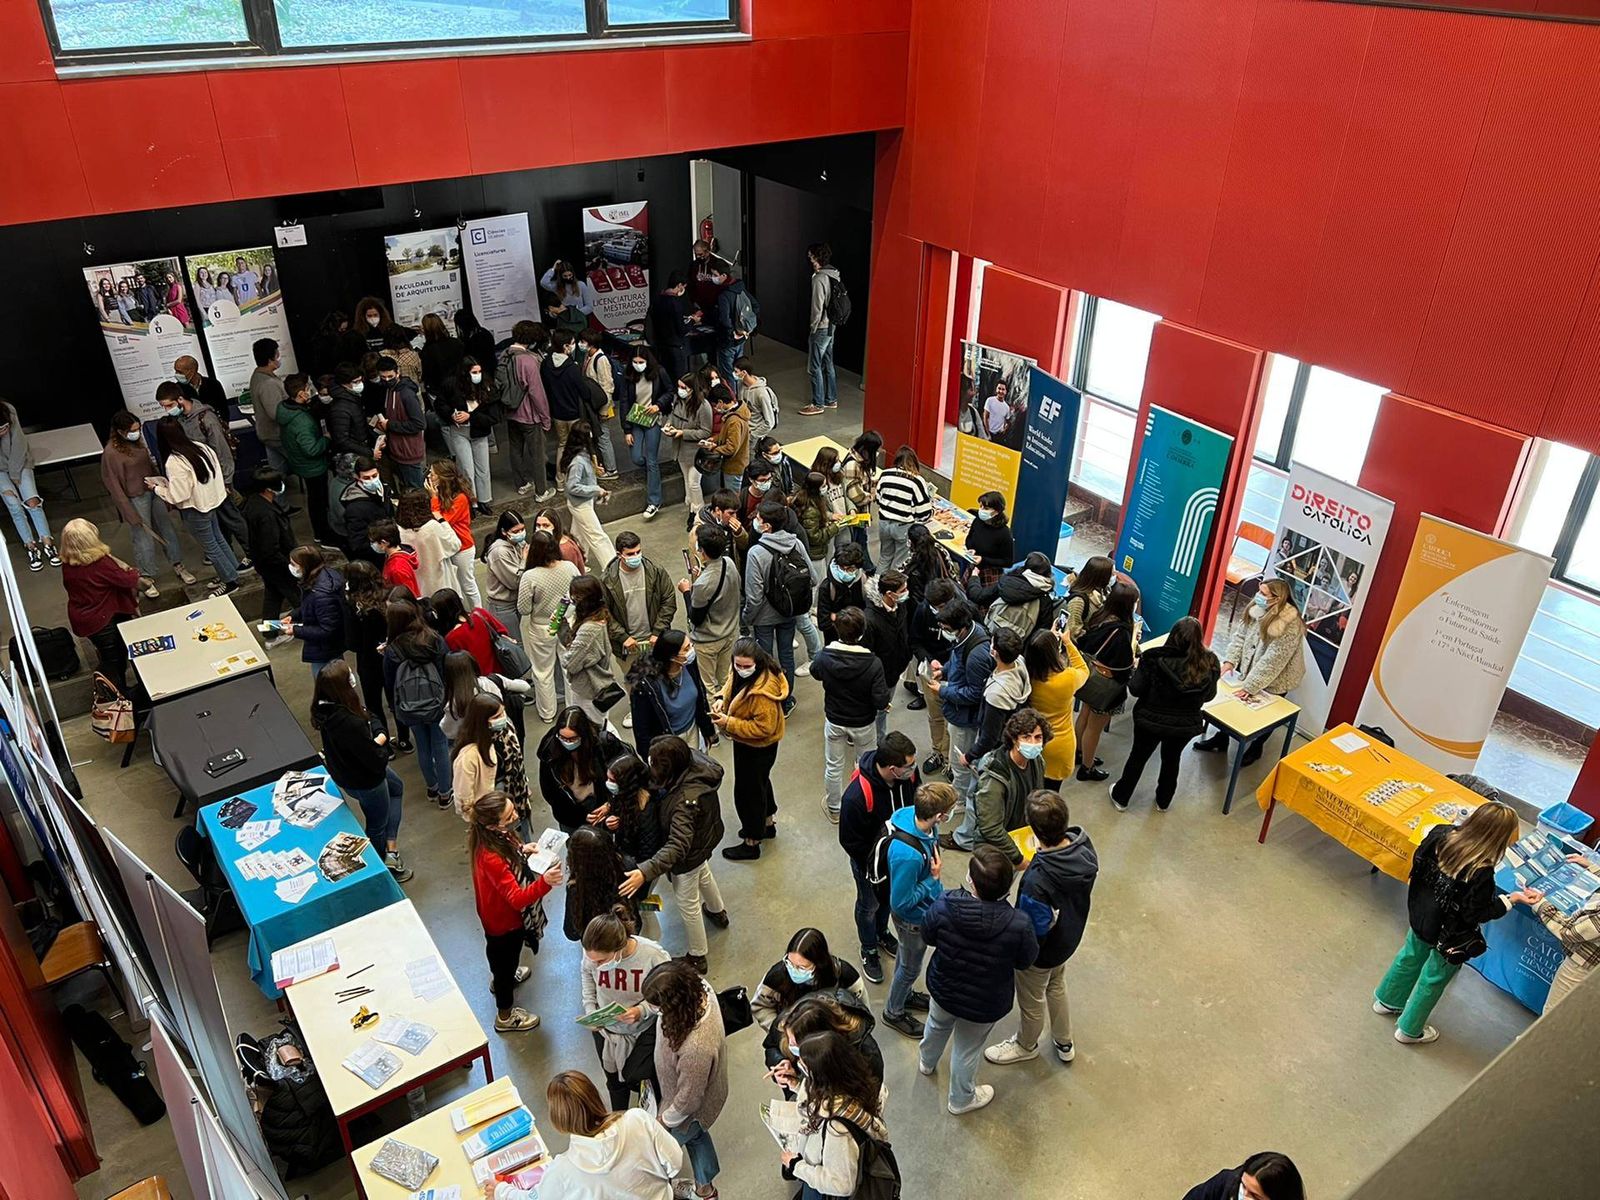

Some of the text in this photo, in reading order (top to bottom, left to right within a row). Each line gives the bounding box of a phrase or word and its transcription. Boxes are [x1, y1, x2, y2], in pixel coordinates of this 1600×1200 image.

[474, 248, 506, 257] Licenciaturas
[395, 280, 433, 291] FACULDADE
[406, 284, 451, 297] ARQUITETURA
[593, 292, 646, 307] LICENCIATURAS
[603, 300, 646, 313] MESTRADOS
[1039, 394, 1062, 421] EF
[1028, 424, 1041, 438] World
[1458, 611, 1499, 633] Transformar
[1444, 616, 1468, 631] Futuro
[1468, 625, 1478, 636] da
[1479, 630, 1502, 645] Saúde
[1442, 633, 1453, 642] em
[1453, 635, 1484, 654] Portugal
[1475, 656, 1505, 673] Mundial
[598, 967, 643, 993] ART
